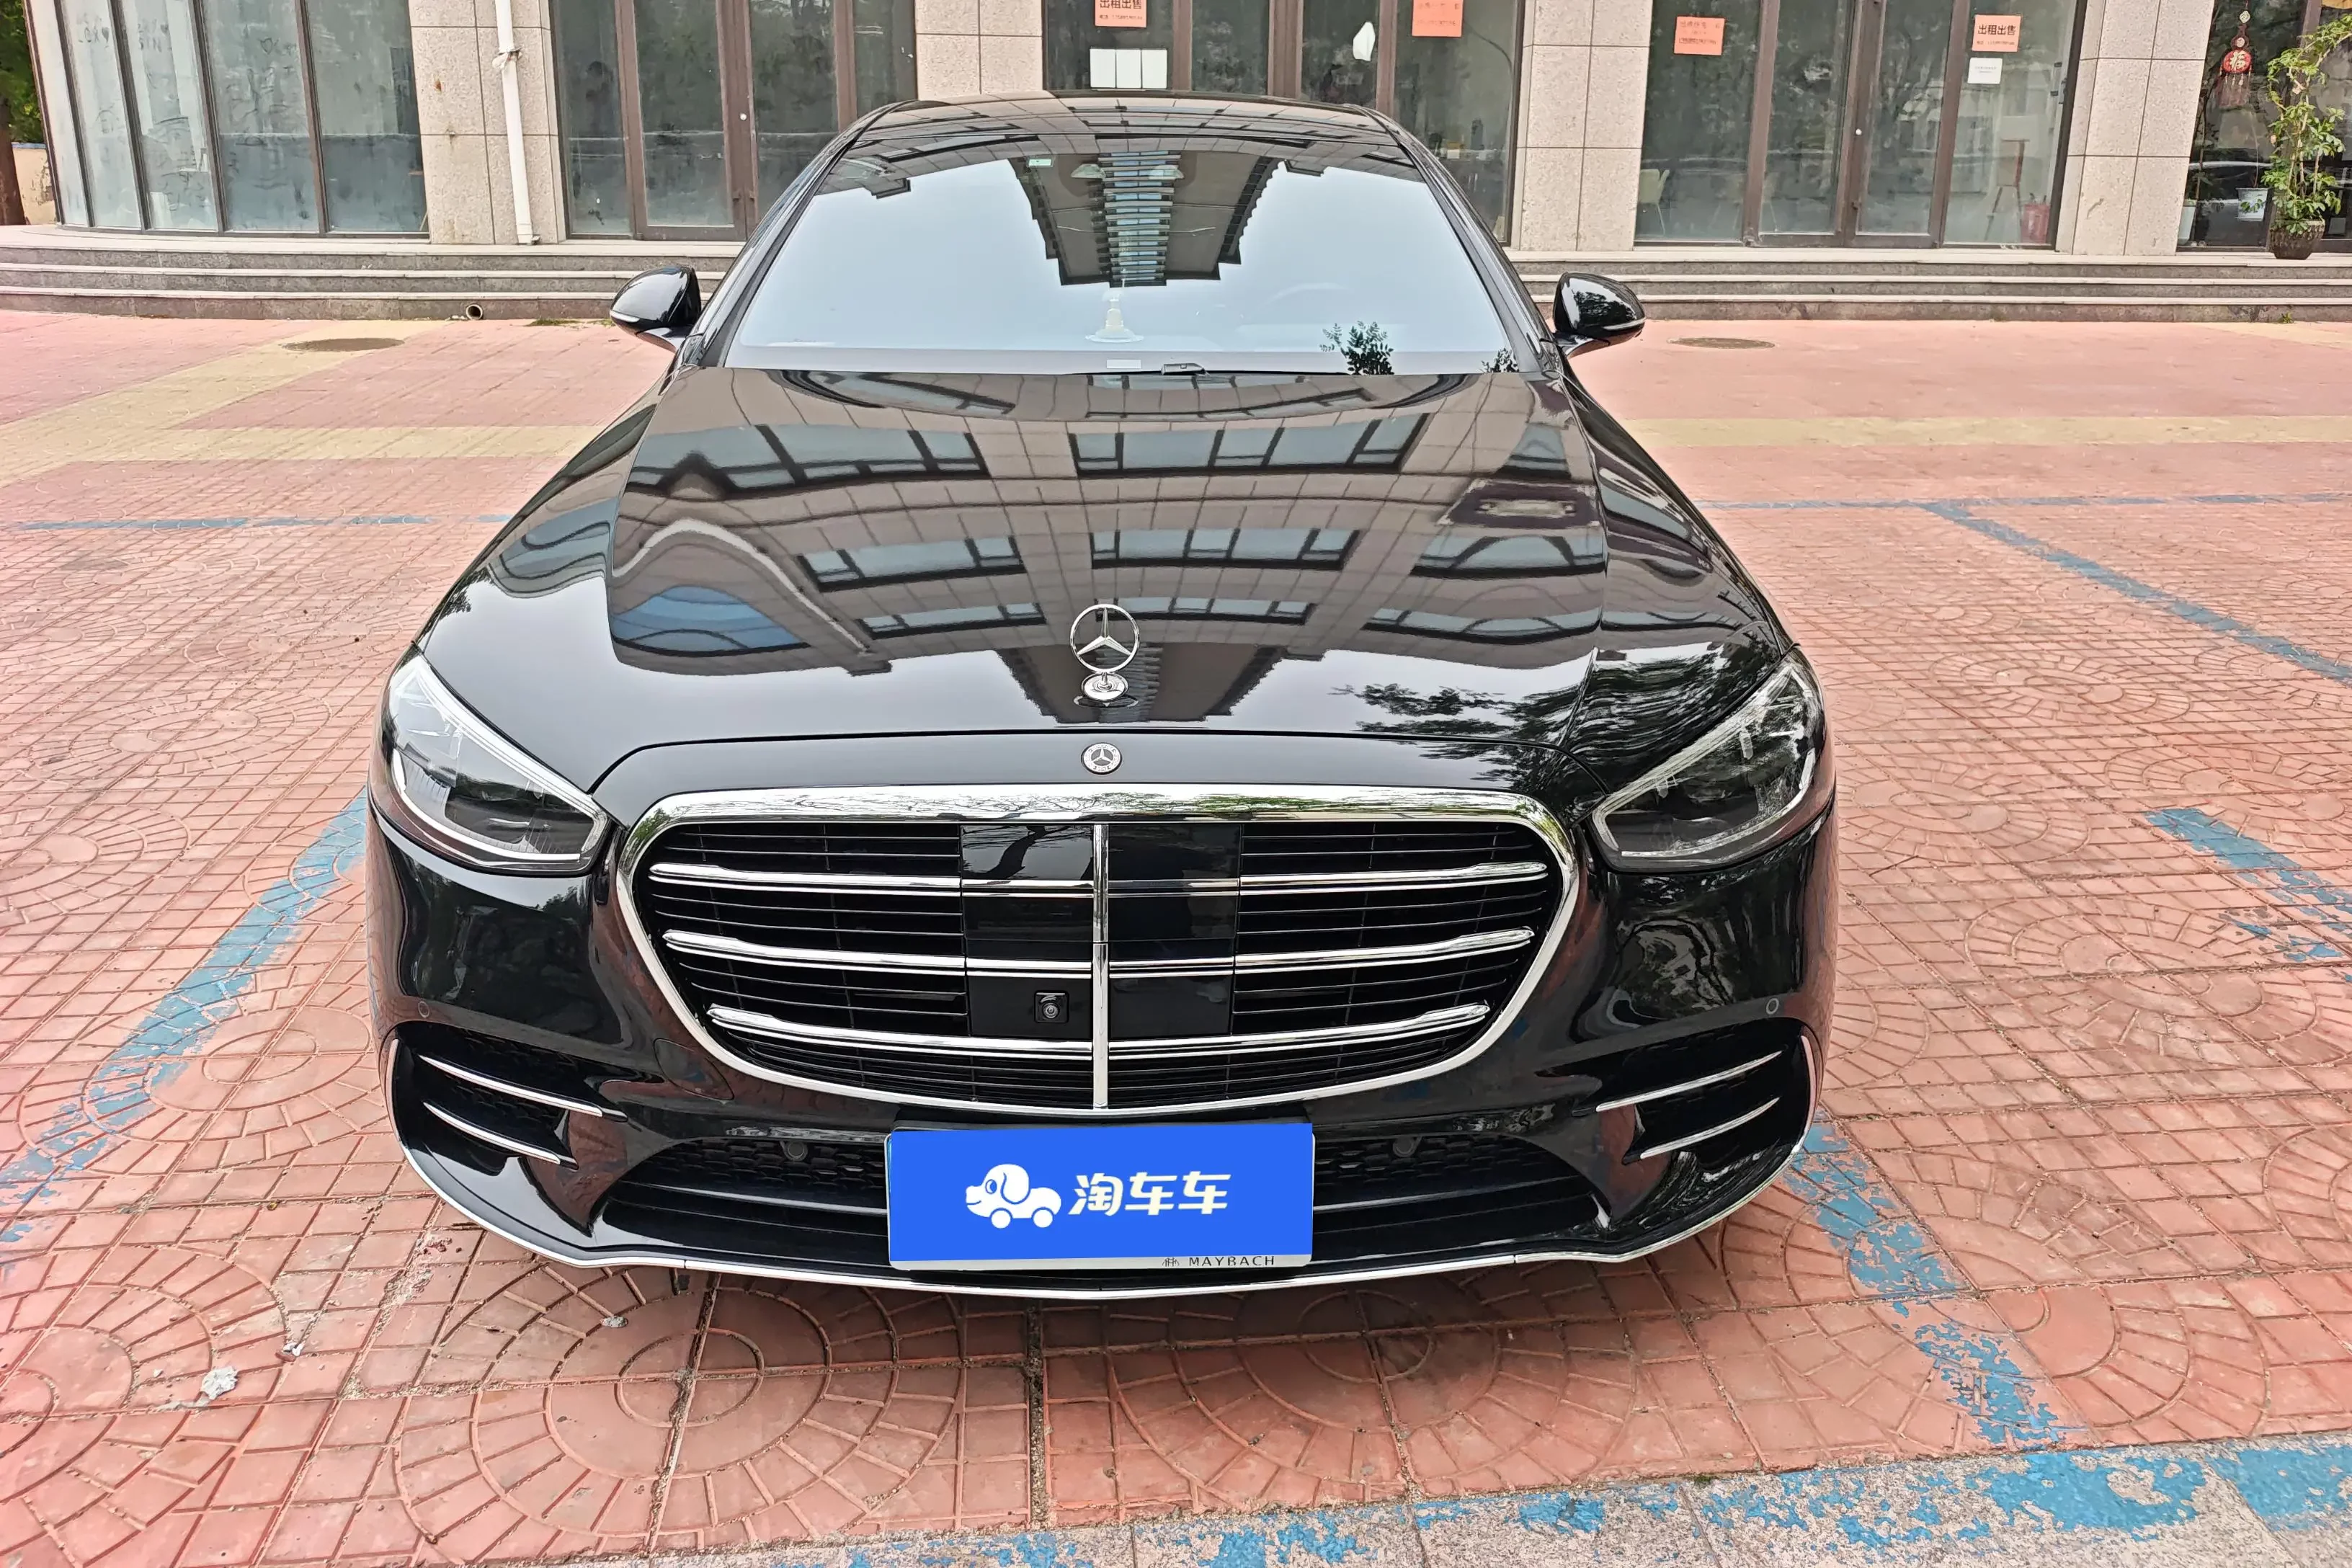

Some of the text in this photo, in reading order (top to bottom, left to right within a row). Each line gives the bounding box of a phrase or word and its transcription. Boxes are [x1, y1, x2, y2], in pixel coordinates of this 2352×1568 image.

[1978, 24, 2016, 35] 出租出售
[1189, 1256, 1274, 1267] MAYBACH
